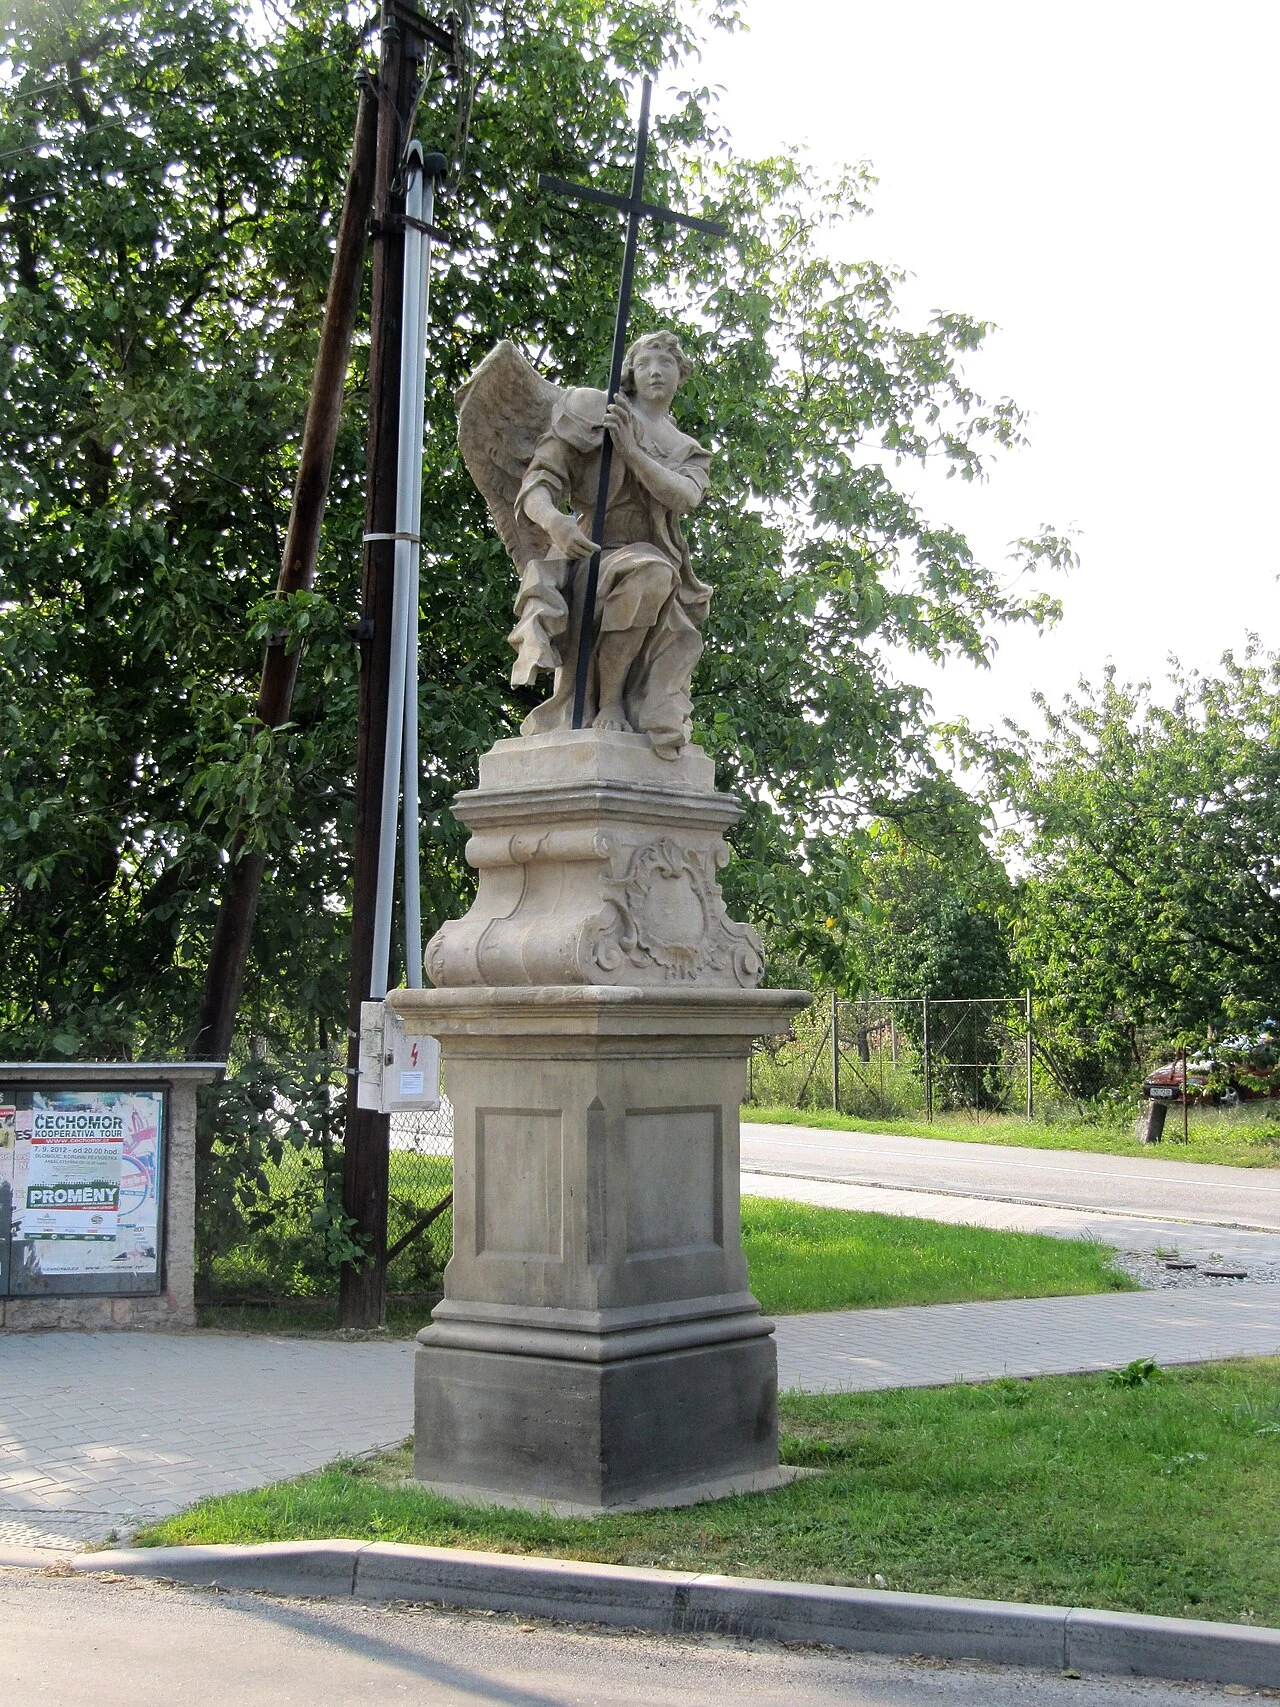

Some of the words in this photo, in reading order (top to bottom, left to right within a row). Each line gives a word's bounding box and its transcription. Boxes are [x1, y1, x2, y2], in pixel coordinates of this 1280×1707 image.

[34, 1114, 123, 1129] ČECHOMOR
[34, 1130, 95, 1138] KOOPERATIVA
[99, 1130, 123, 1138] TOUR
[84, 1147, 103, 1155] 20.00
[30, 1187, 118, 1204] PROMĚNY
